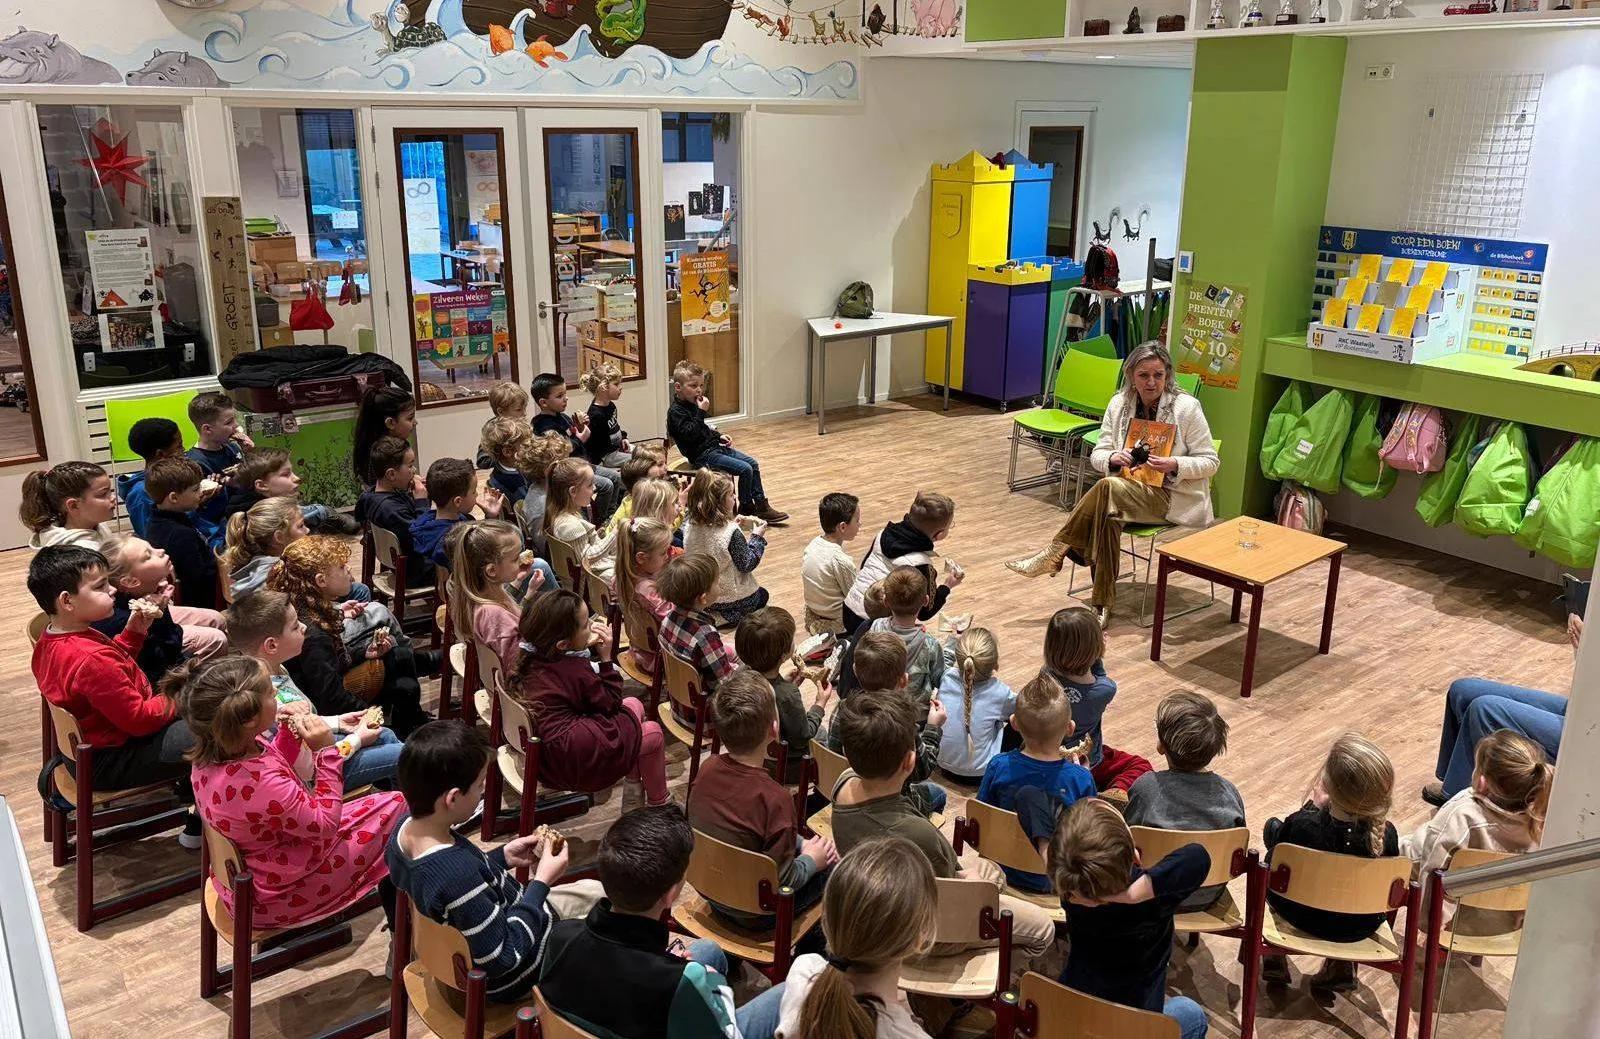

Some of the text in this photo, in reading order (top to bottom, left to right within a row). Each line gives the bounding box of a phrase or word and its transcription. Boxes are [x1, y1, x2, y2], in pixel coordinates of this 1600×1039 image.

[1390, 235, 1462, 251] SCOOR EEN BOEK!
[693, 261, 717, 269] GRATIS
[433, 294, 464, 304] Zilveren
[465, 292, 489, 302] Weken
[1189, 291, 1203, 301] DE
[223, 282, 238, 331] GROEIT
[1188, 303, 1233, 318] PRENTEN
[1198, 317, 1225, 330] BOEK
[1187, 328, 1207, 339] TOP
[1208, 340, 1228, 358] 10
